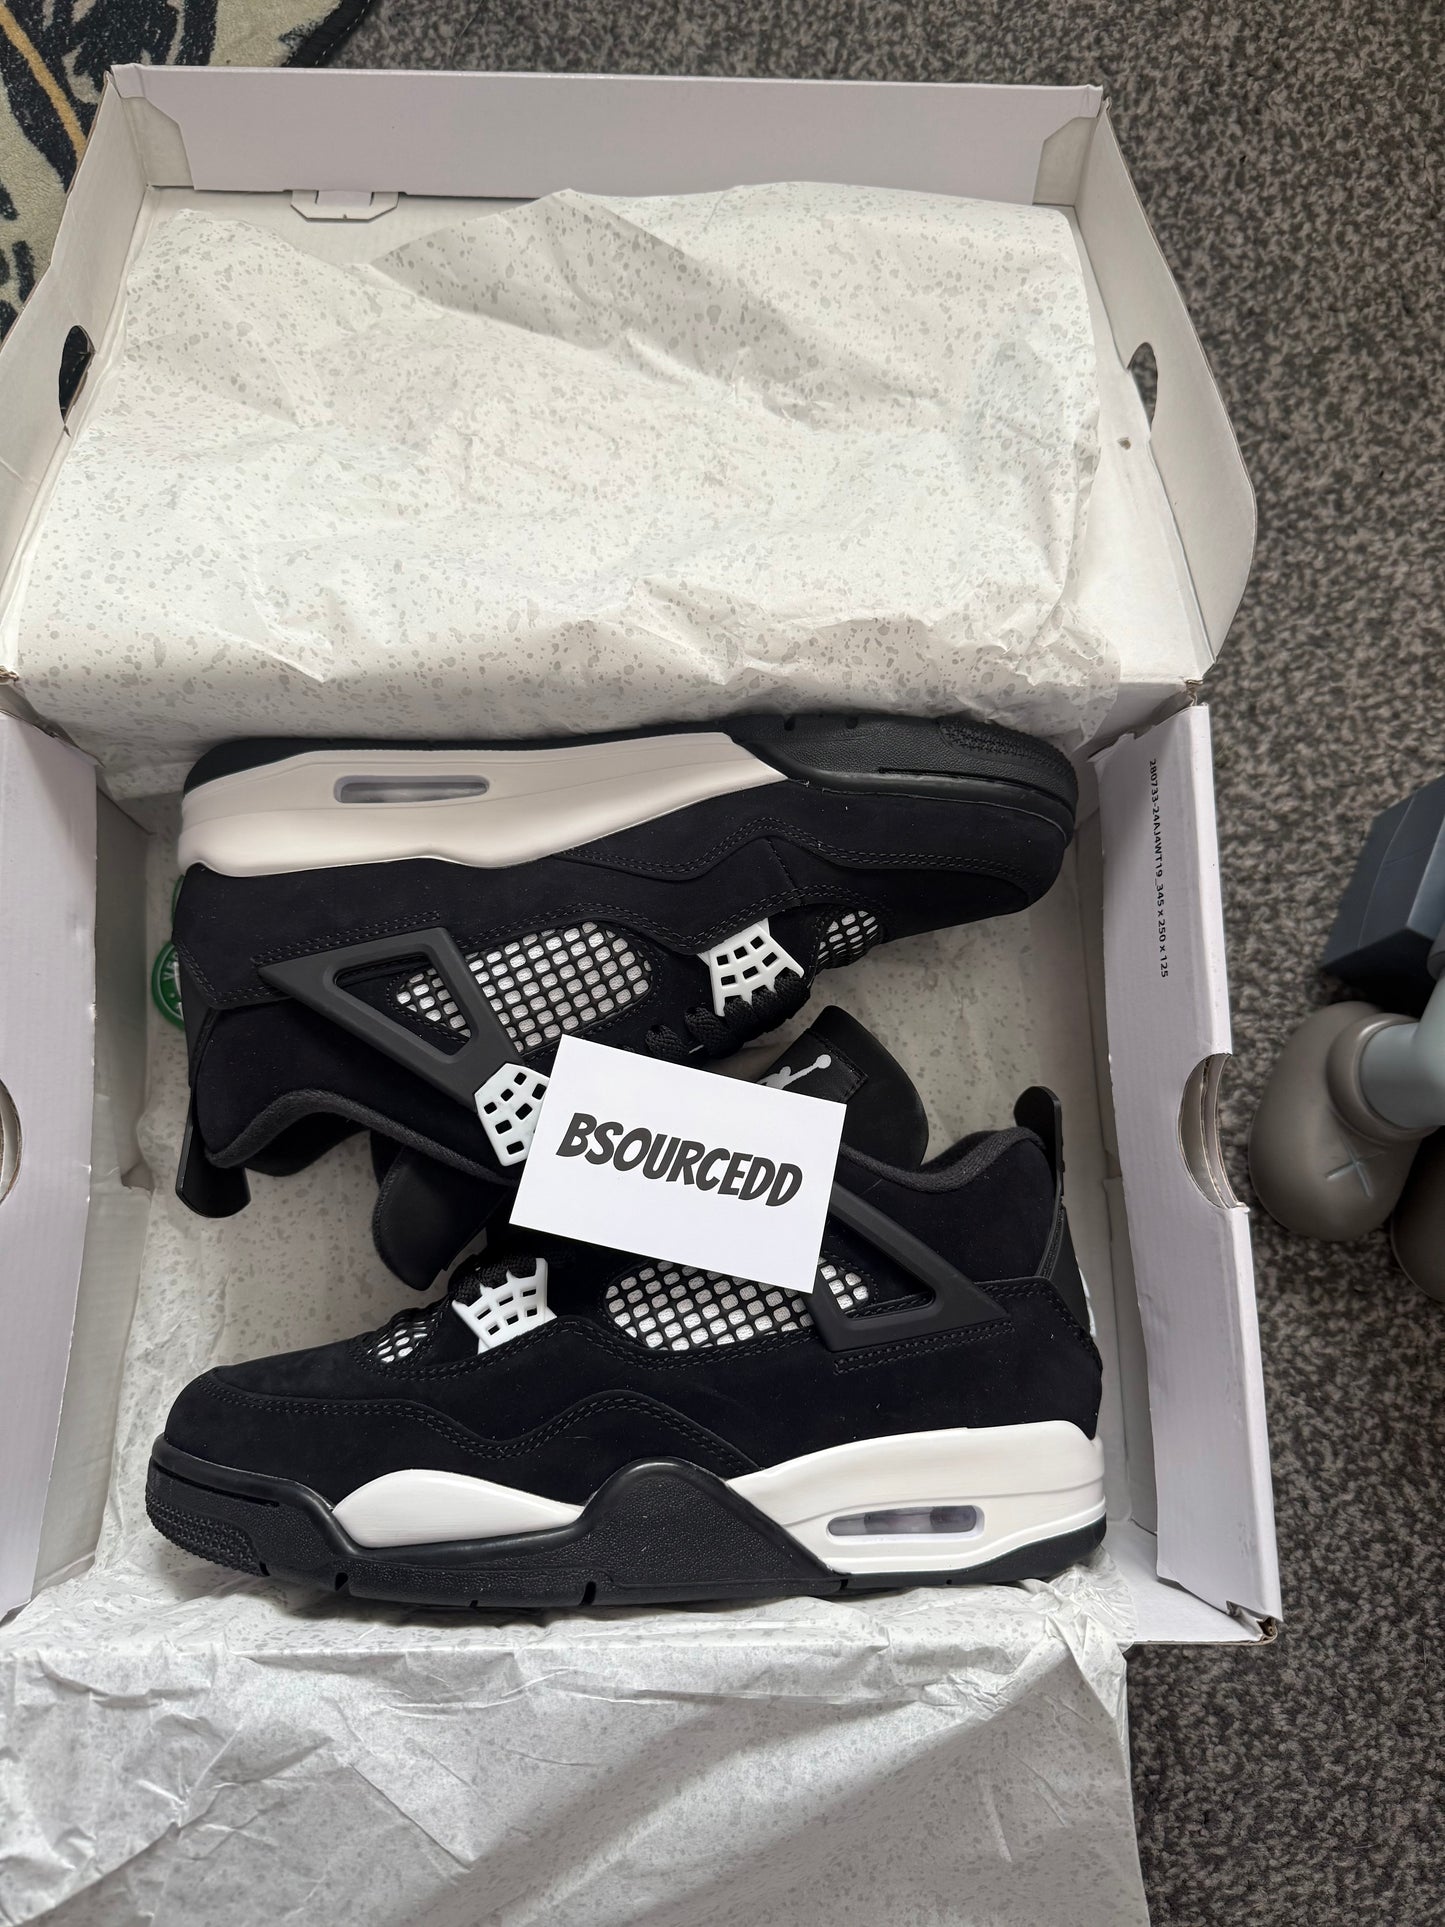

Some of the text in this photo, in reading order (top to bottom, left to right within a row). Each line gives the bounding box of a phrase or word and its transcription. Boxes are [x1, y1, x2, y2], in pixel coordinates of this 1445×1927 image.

[1157, 918, 1166, 943] 250
[1160, 954, 1169, 978] 125
[555, 1112, 803, 1207] BSOURCEDD
